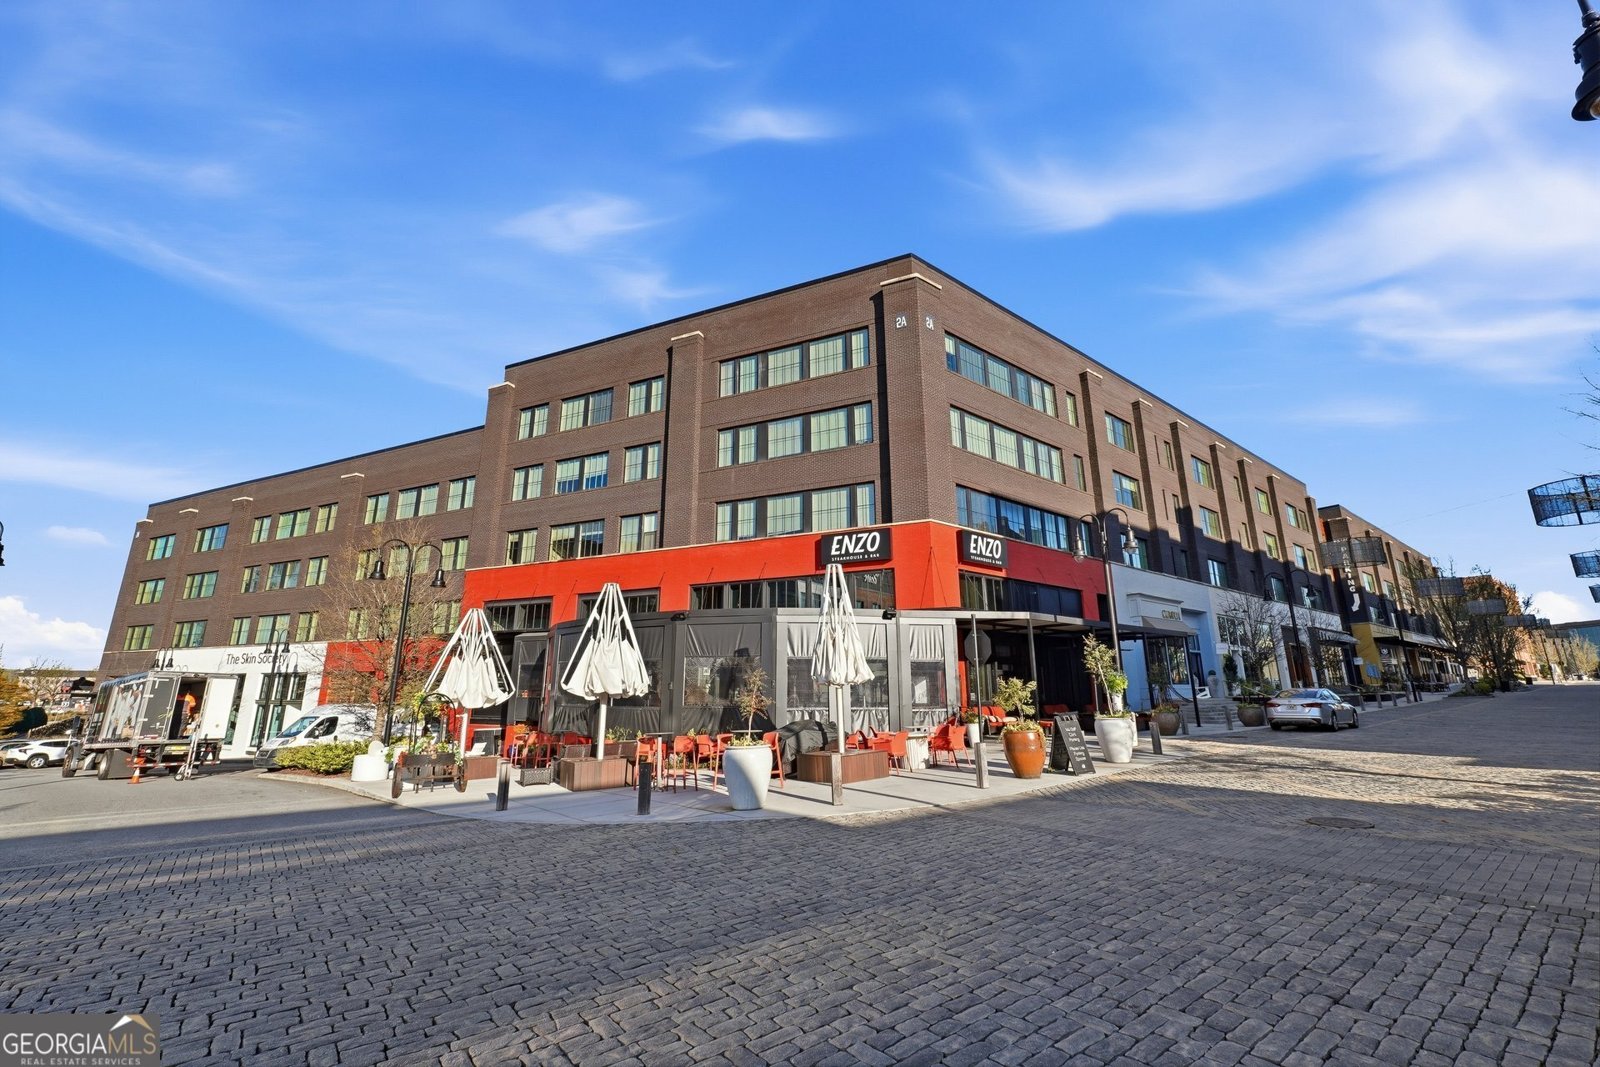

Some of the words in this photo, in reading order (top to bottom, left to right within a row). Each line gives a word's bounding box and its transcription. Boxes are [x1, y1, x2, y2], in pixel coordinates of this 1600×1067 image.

[896, 316, 907, 328] 2A
[926, 316, 934, 330] 2A
[831, 531, 880, 555] ENZO
[969, 534, 1002, 559] ENZO
[831, 554, 863, 562] STEAKHOUSE
[1340, 546, 1356, 592] PARKING
[226, 653, 240, 665] The
[241, 652, 257, 665] Skin
[257, 652, 287, 666] Socty
